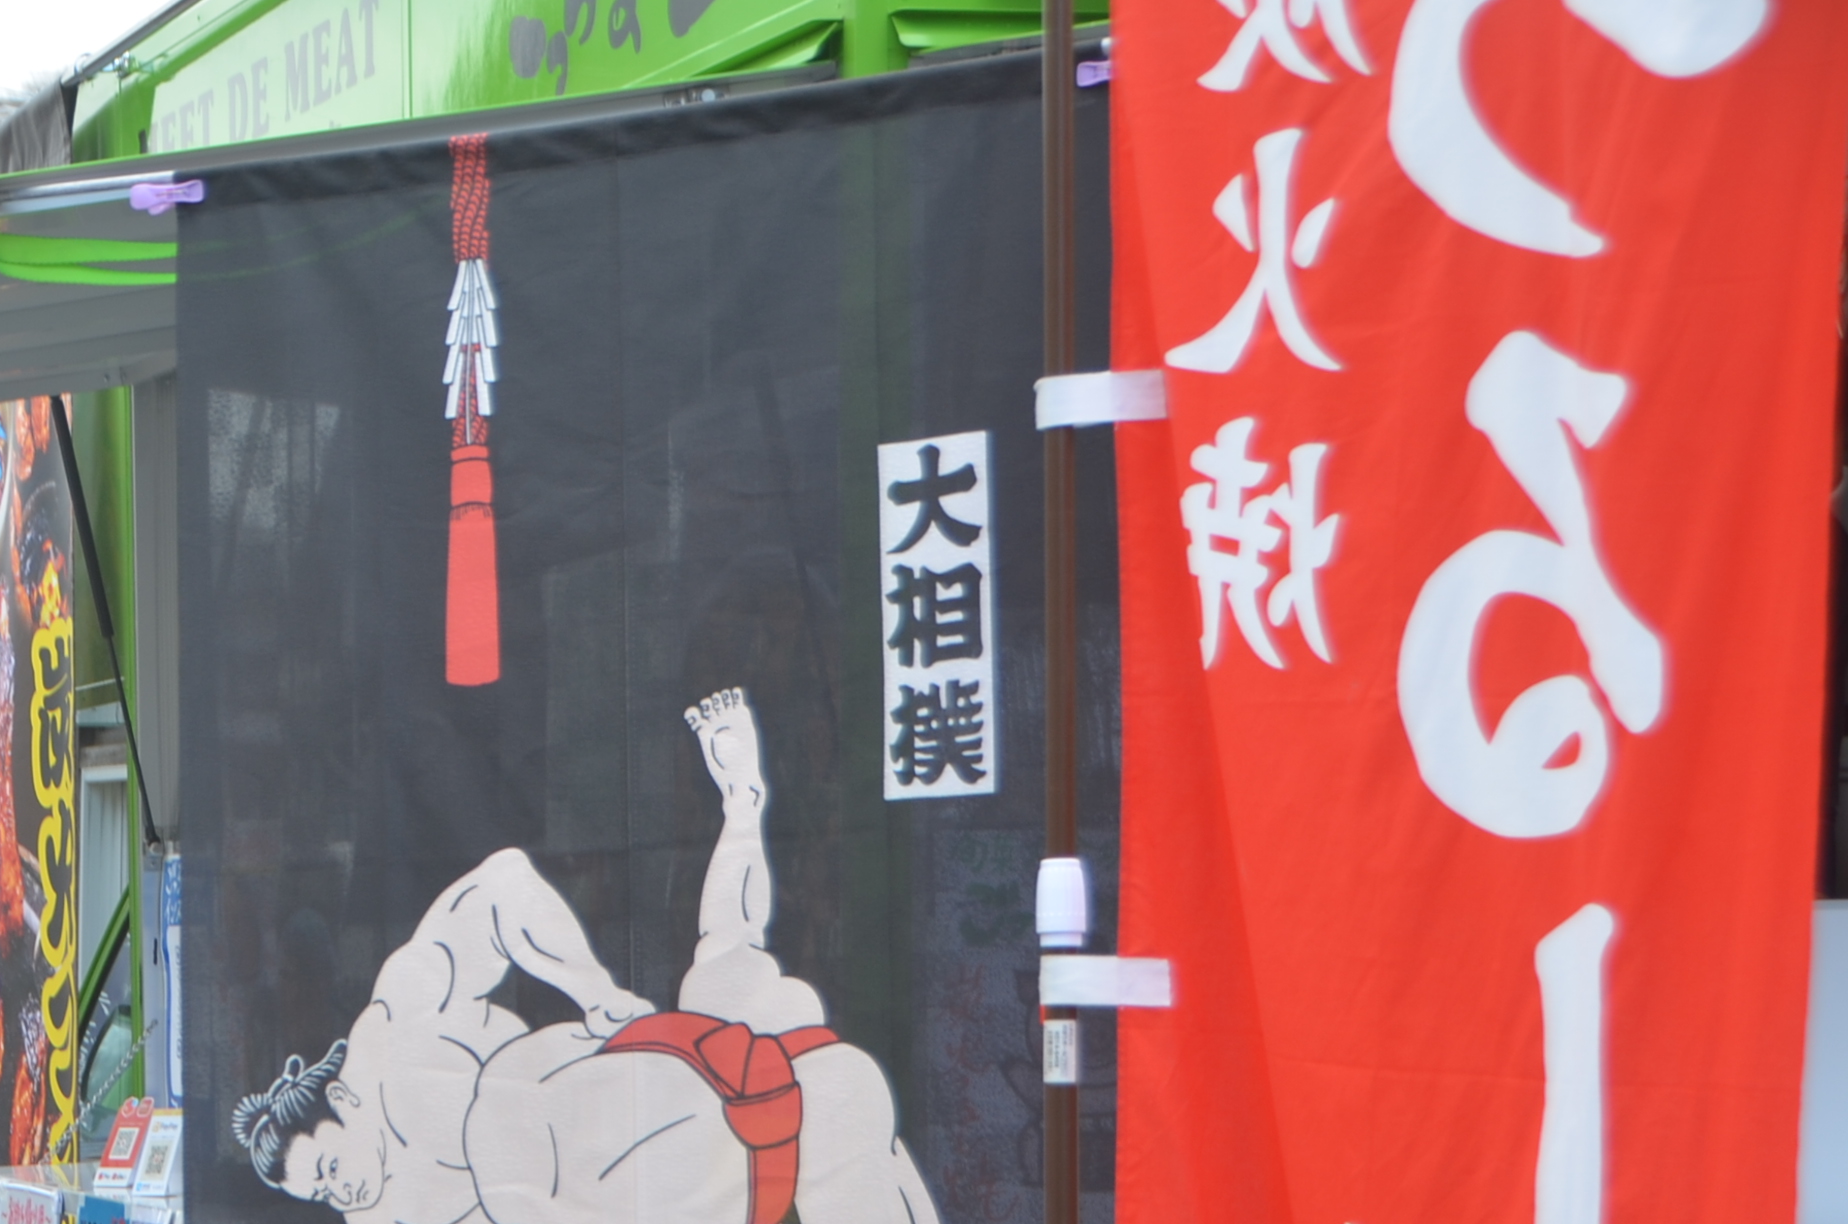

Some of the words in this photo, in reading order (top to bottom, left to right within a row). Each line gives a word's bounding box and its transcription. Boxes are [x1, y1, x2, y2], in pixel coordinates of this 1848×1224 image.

[150, 88, 214, 150] EET
[227, 56, 270, 143] DE
[285, 0, 379, 122] MEAT
[885, 443, 987, 786] 大相撲
